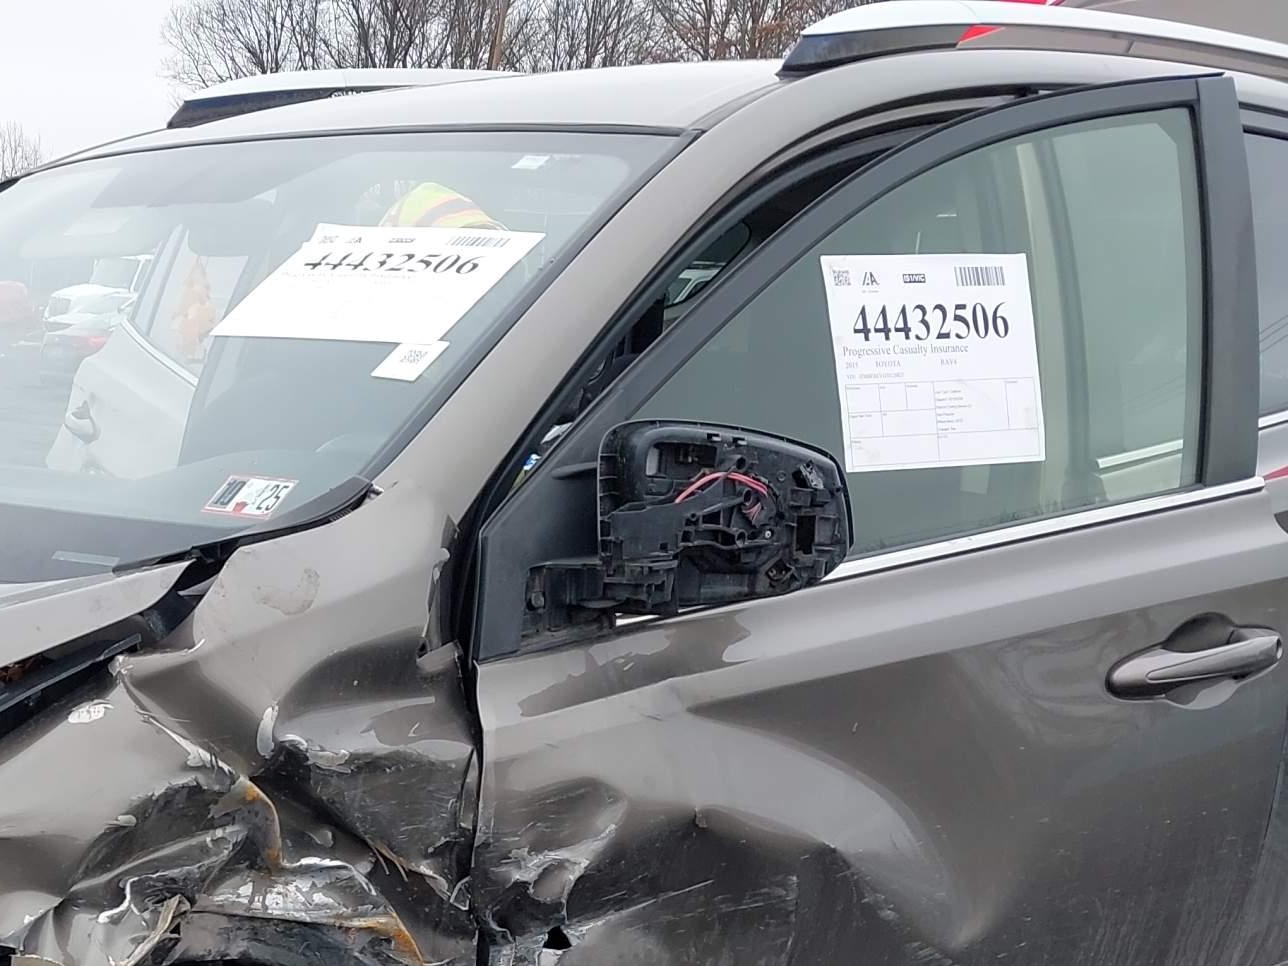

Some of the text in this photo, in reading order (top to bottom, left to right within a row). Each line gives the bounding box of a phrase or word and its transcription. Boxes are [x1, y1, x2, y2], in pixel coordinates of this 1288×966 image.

[304, 252, 486, 274] 44432506
[853, 302, 1009, 341] 44432506
[843, 343, 969, 359] Progressive Casualty Insurance
[256, 484, 290, 511] 25
